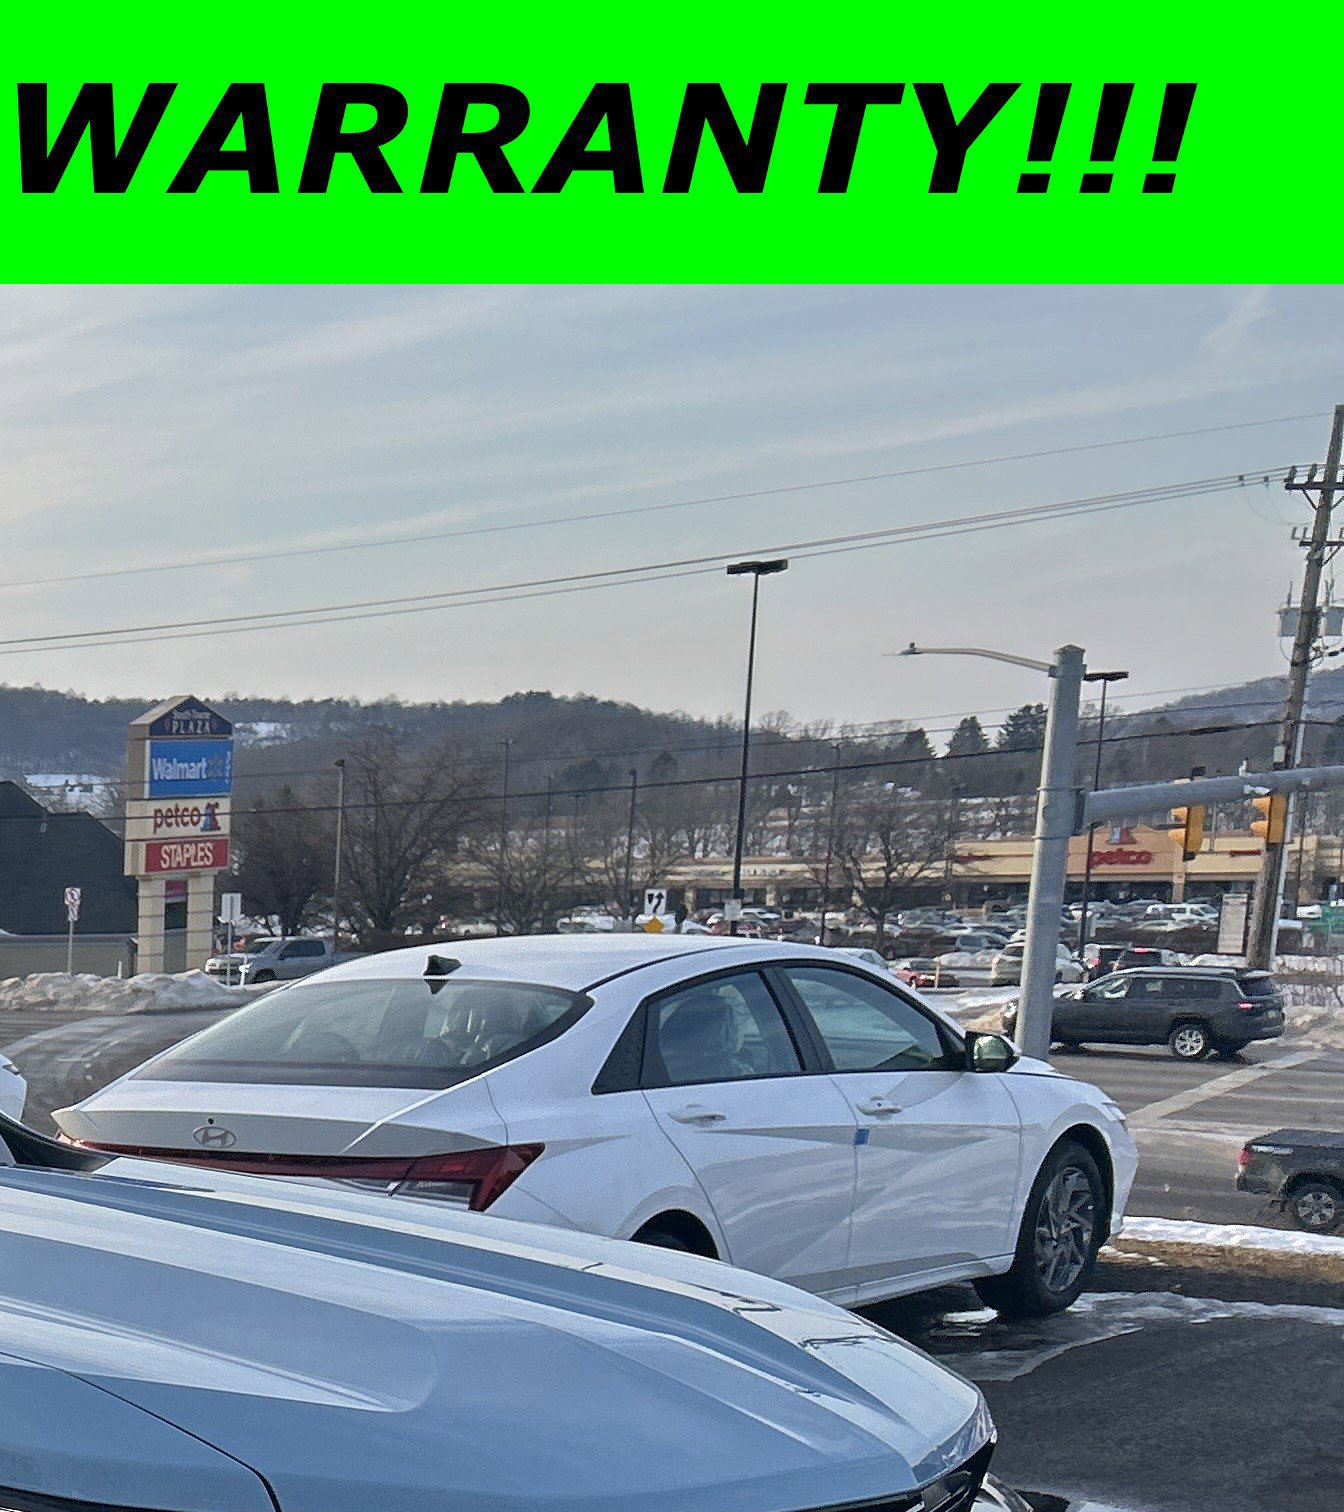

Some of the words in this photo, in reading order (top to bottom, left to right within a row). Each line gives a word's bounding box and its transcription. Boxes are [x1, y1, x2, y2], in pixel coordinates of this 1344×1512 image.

[172, 720, 210, 734] PLAZA
[153, 758, 207, 780] Walmart
[153, 803, 201, 835] petco
[161, 843, 213, 868] STAPLES
